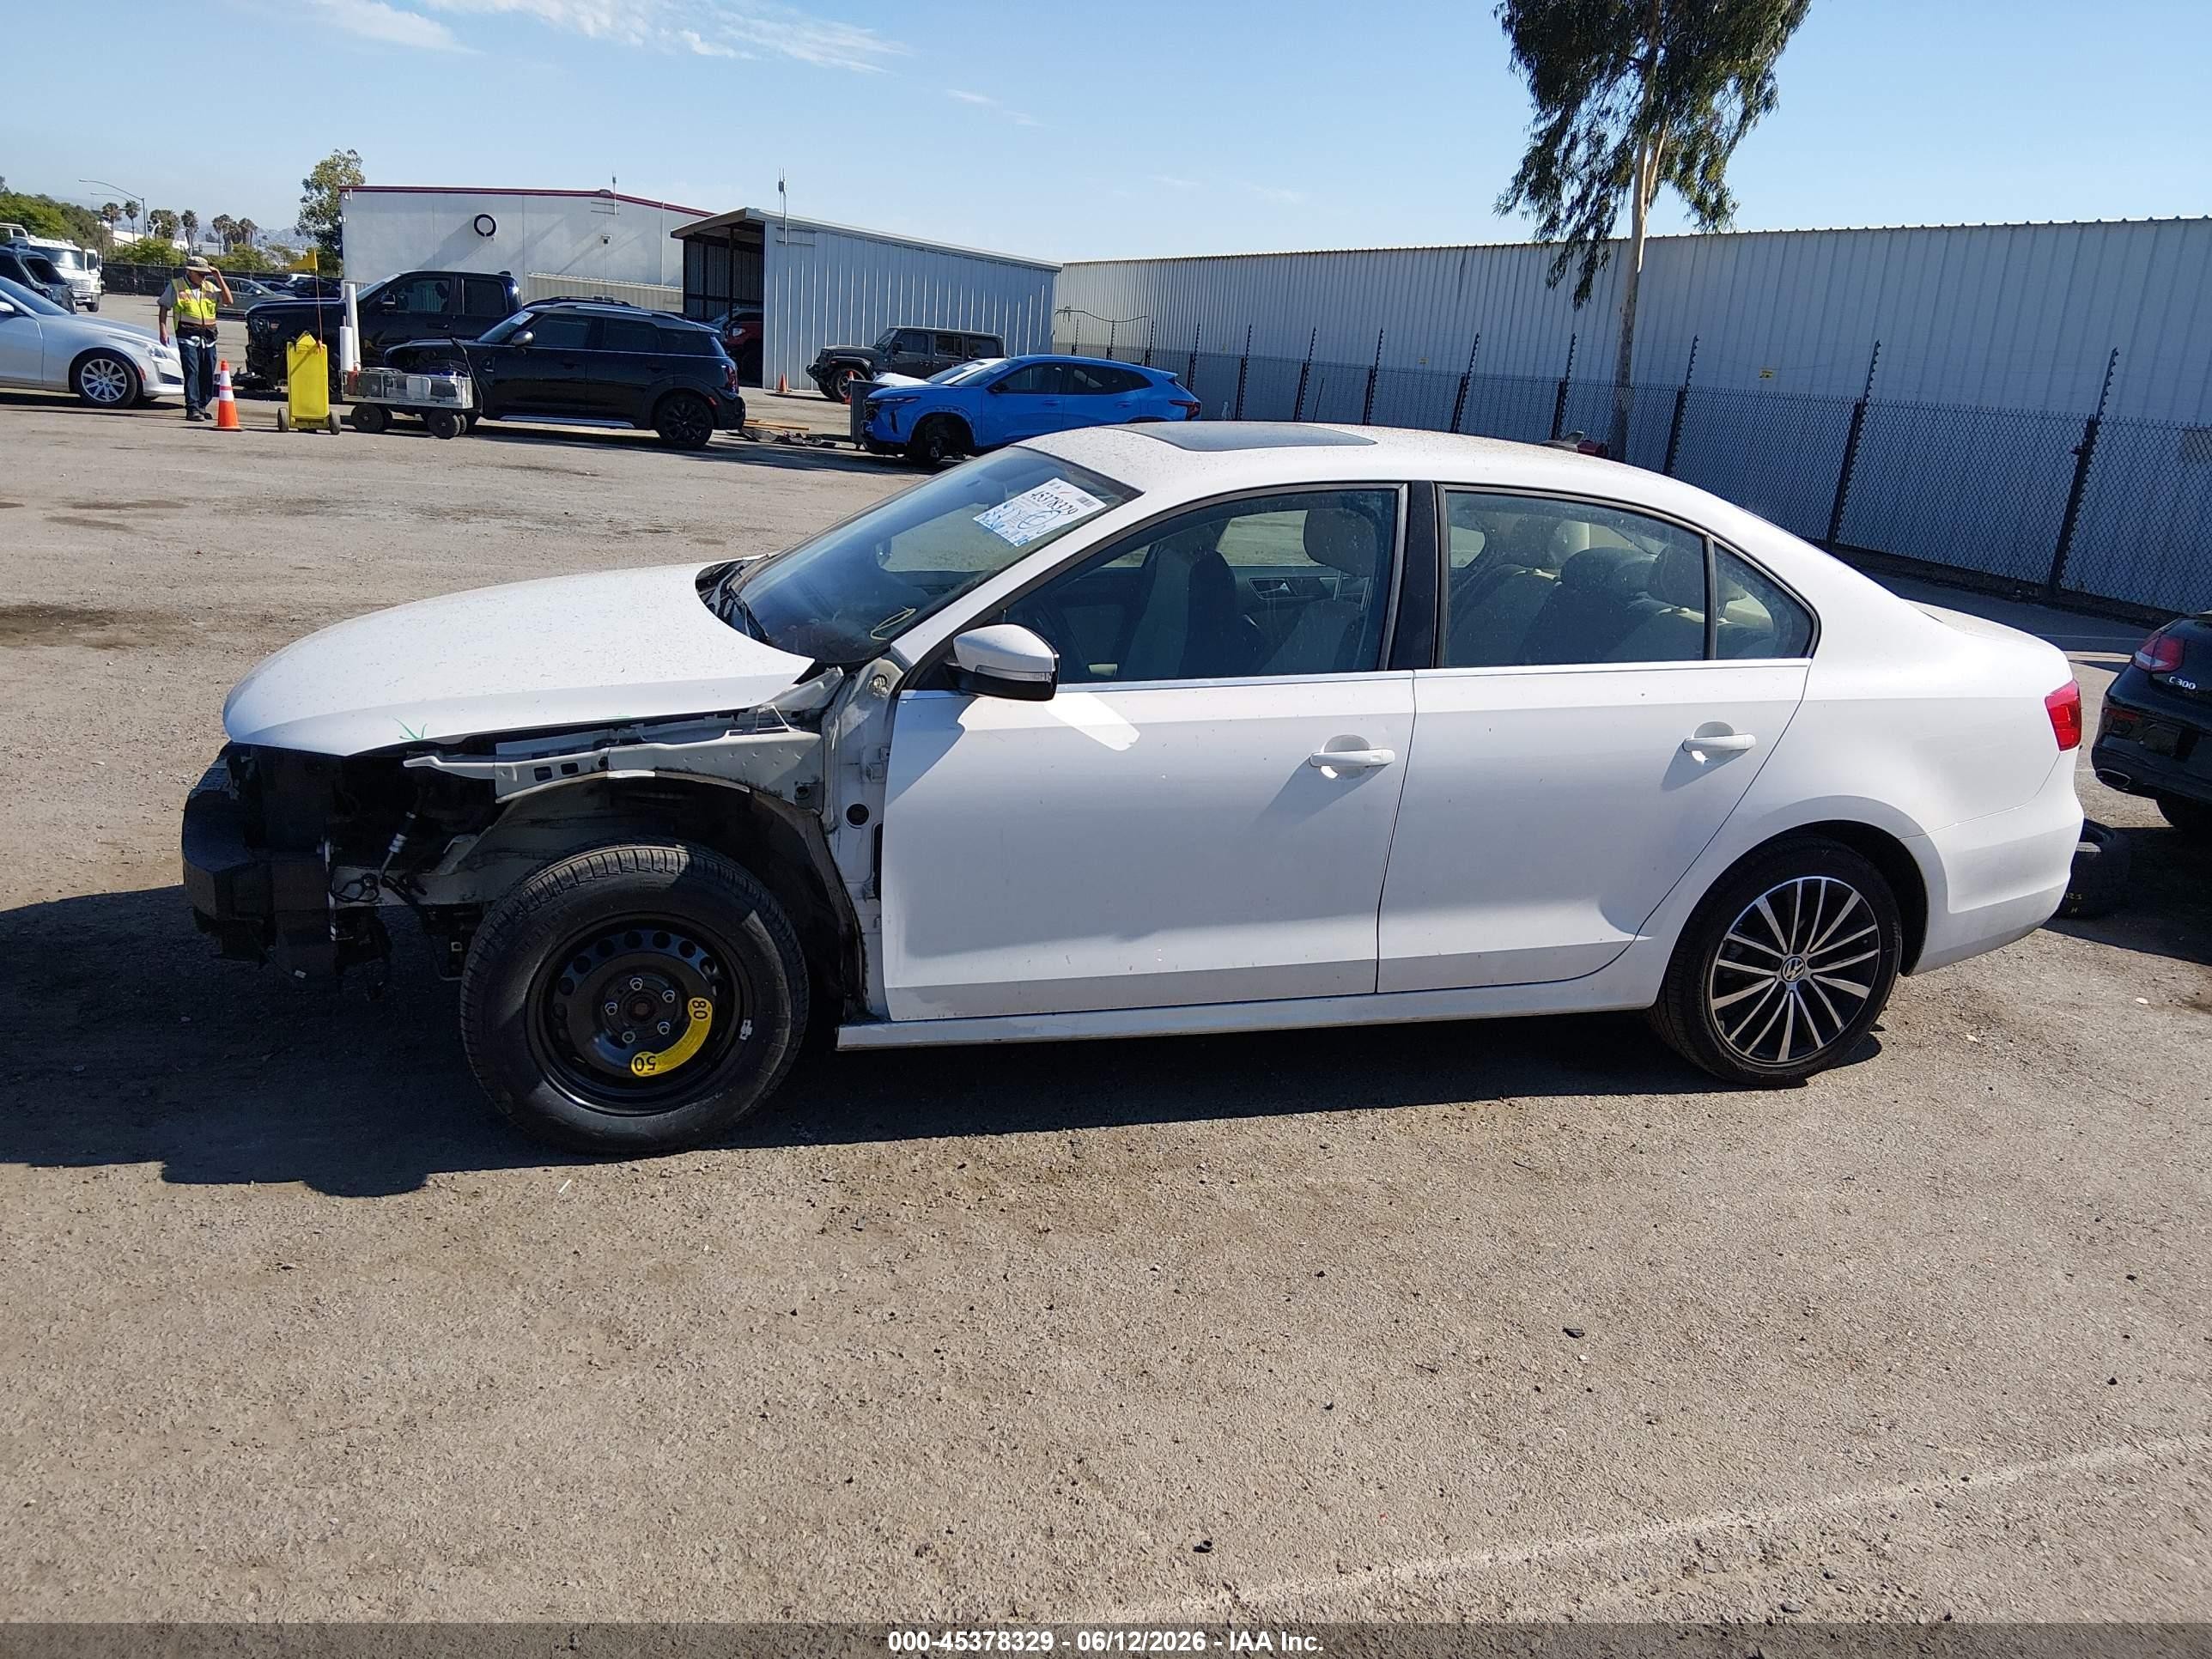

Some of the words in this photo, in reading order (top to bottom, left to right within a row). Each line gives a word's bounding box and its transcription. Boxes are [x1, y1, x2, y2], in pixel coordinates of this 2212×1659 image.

[2177, 678, 2196, 690] 300
[692, 1000, 708, 1020] 80
[634, 1055, 656, 1073] 50
